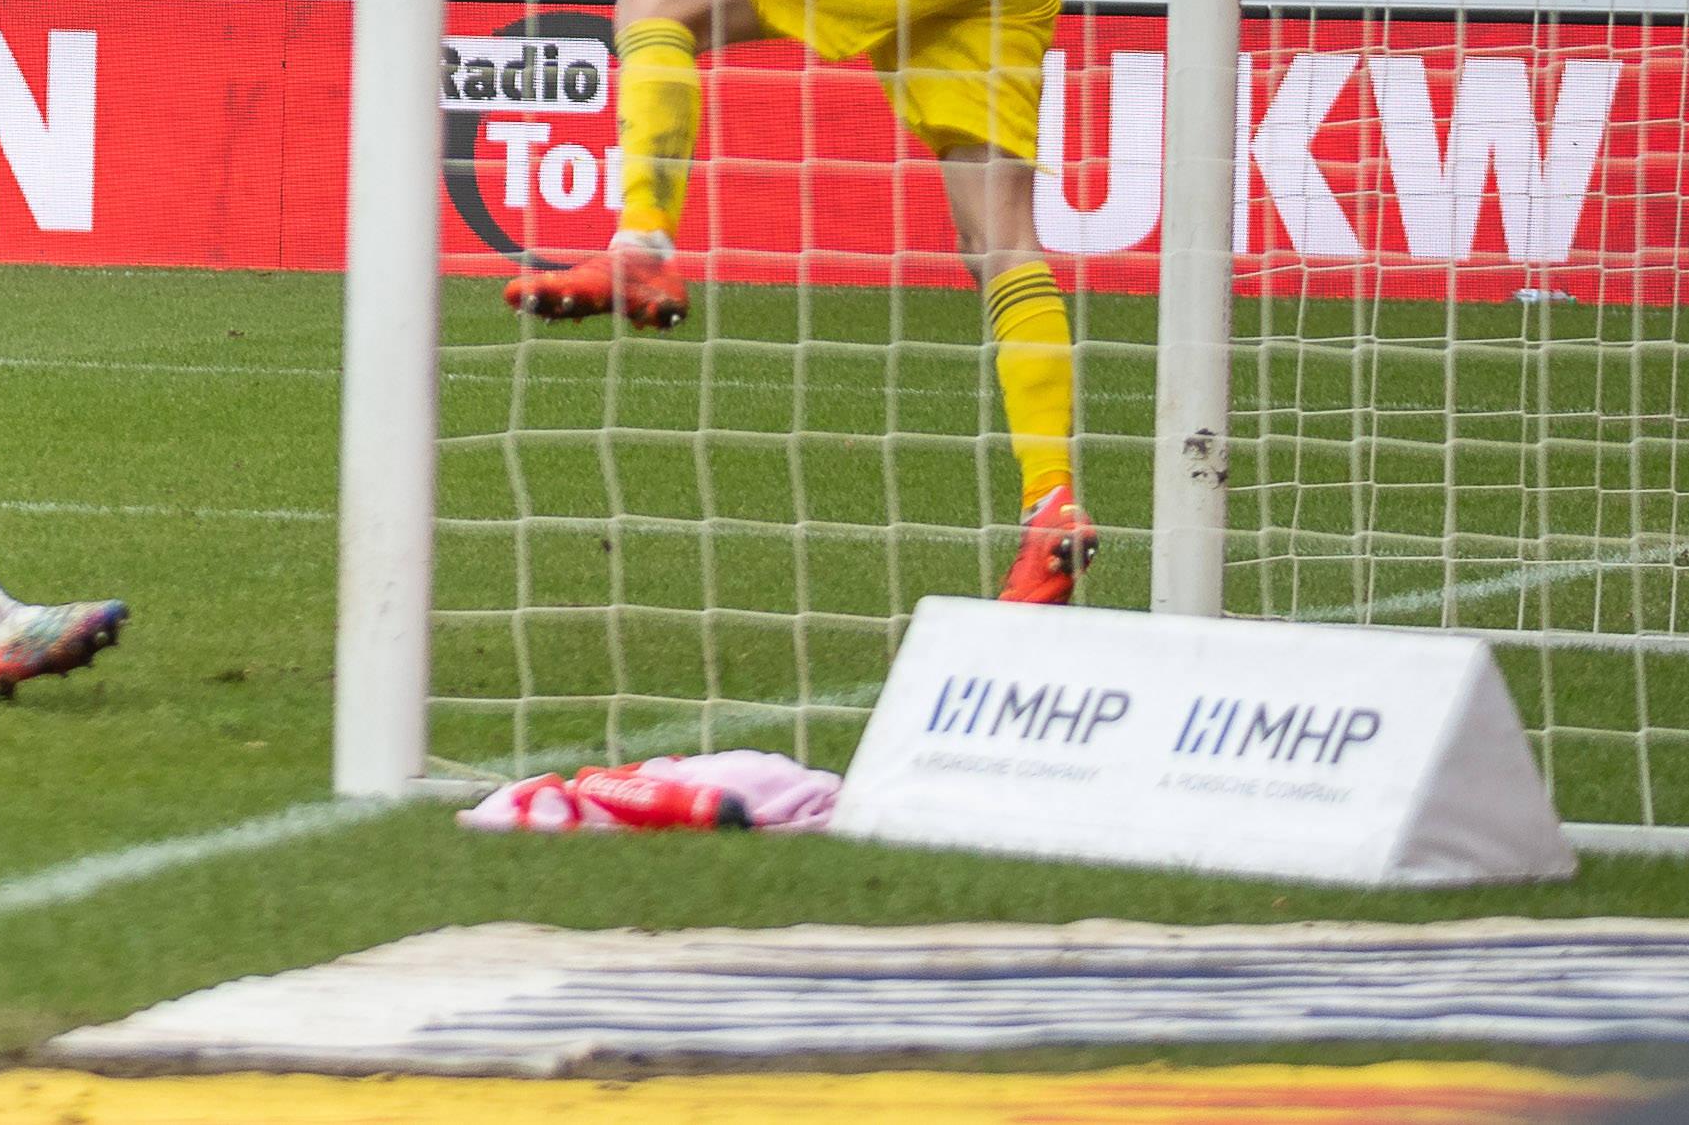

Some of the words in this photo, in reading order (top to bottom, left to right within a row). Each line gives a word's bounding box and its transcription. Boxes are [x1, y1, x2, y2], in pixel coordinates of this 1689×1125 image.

[1033, 50, 1622, 263] UKW
[988, 681, 1132, 745] MHP
[1237, 702, 1383, 765] MHP
